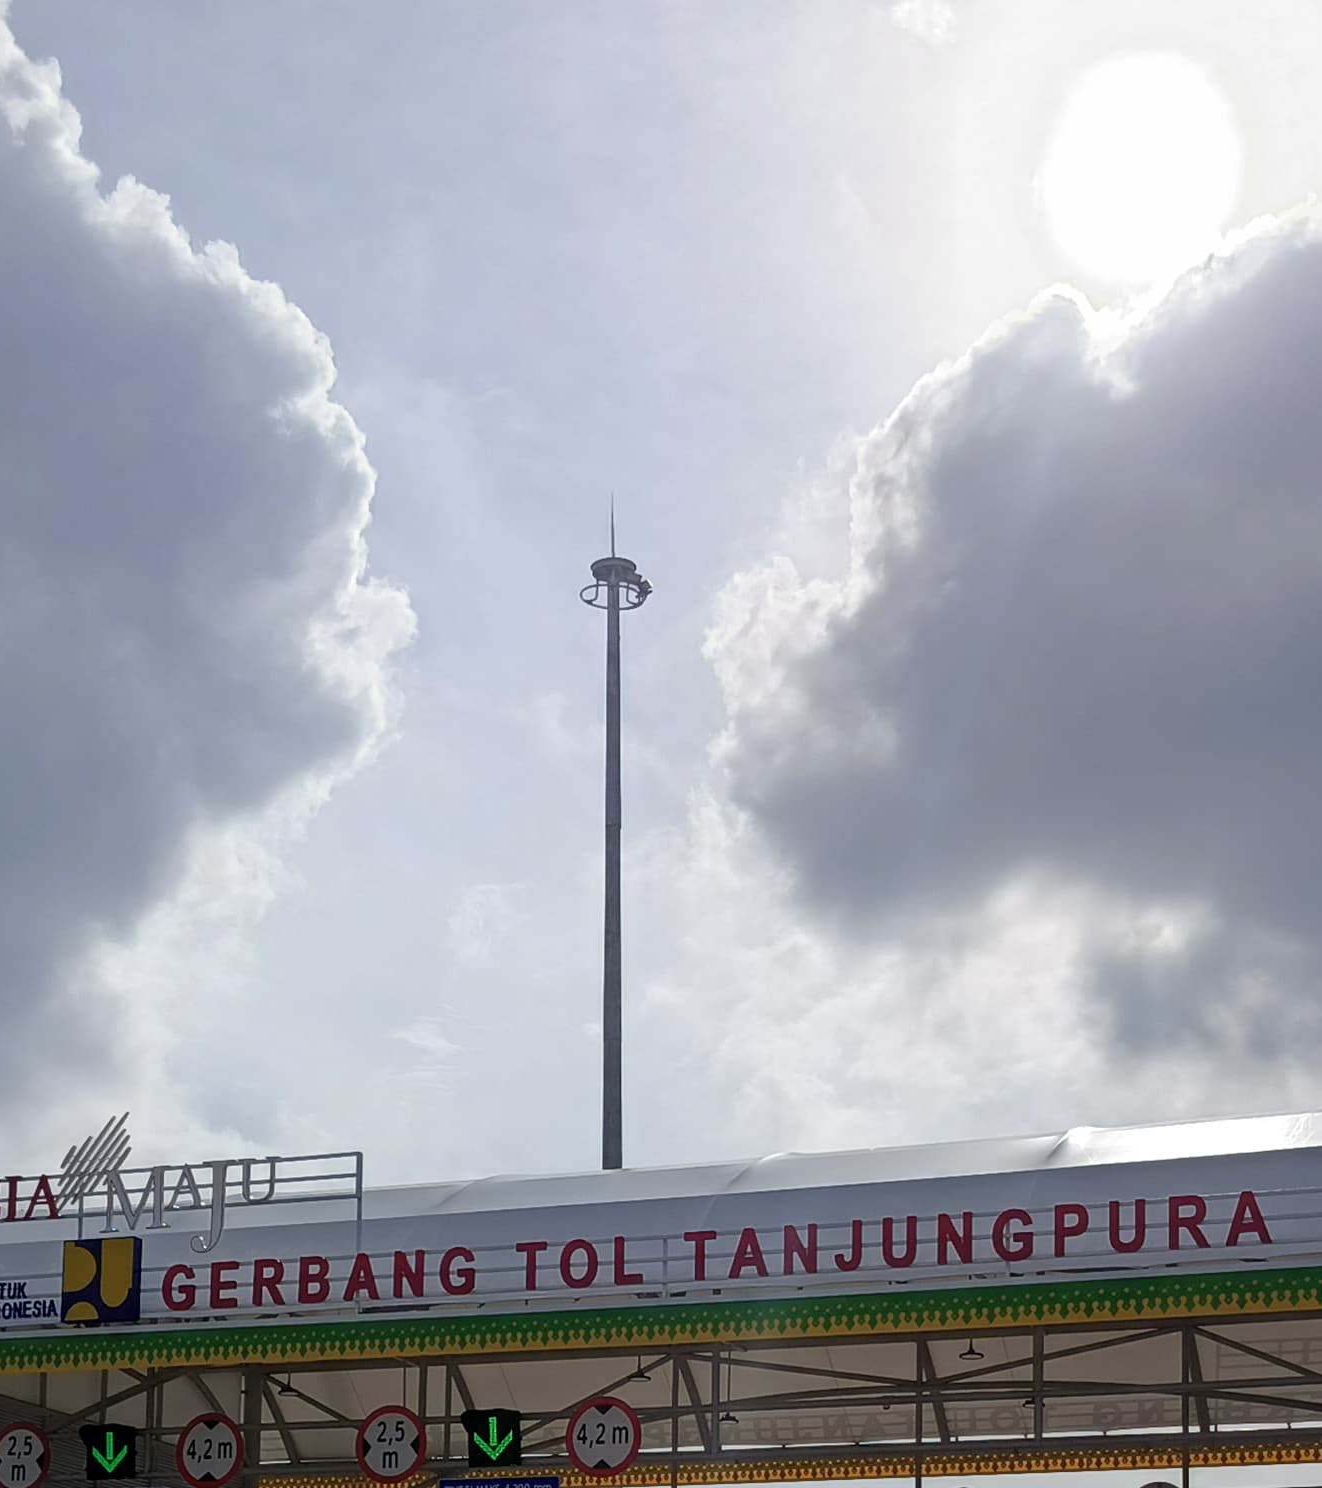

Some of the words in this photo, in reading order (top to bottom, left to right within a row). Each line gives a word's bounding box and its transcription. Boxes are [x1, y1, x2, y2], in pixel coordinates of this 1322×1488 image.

[98, 1154, 279, 1252] MAJU
[162, 1247, 476, 1311] GERBANG
[516, 1236, 643, 1292] TOL
[684, 1190, 1274, 1282] TANJUNGPURA
[376, 1420, 405, 1446] 2,5
[576, 1423, 606, 1451] 4,2
[612, 1425, 629, 1444] m
[7, 1435, 33, 1460] 2,5
[186, 1438, 213, 1465] 4,2
[217, 1441, 233, 1459] m
[382, 1450, 399, 1469] m
[11, 1463, 26, 1481] m
